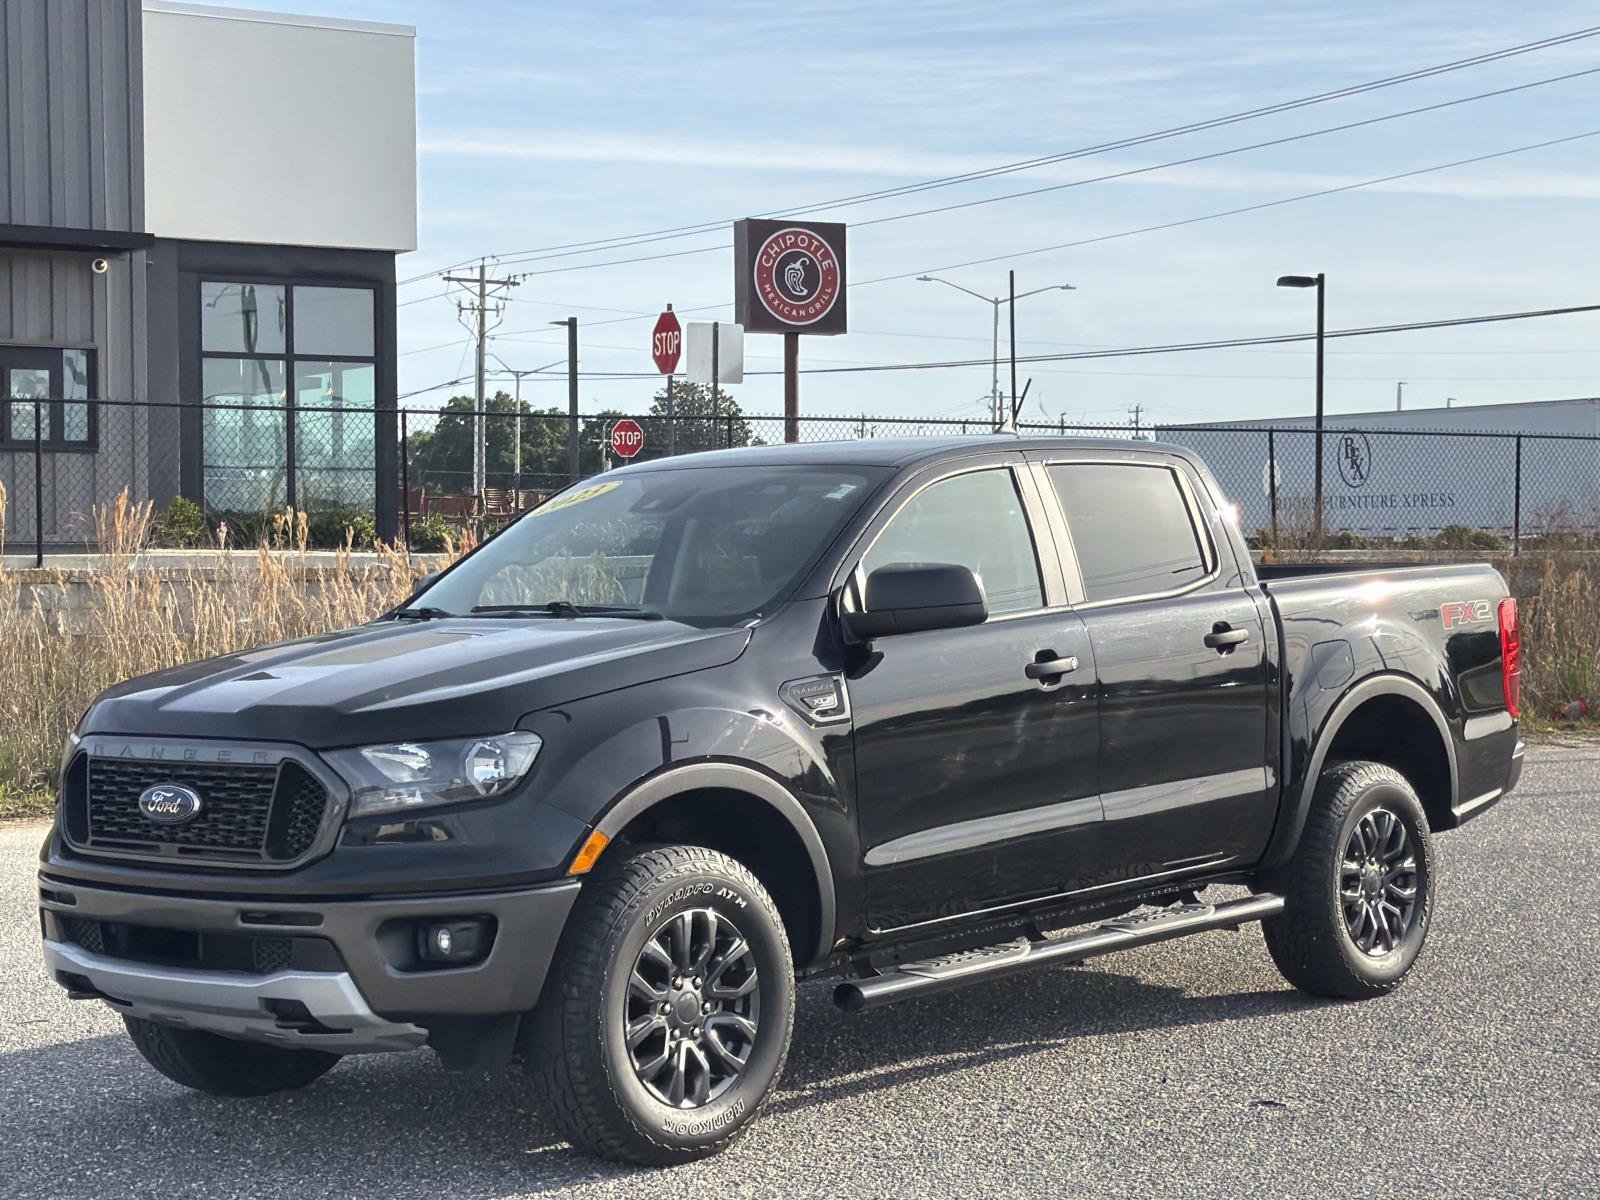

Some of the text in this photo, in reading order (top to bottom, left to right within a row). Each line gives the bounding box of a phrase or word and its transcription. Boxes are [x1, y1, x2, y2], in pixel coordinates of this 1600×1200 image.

[762, 235, 834, 270] CHIPOTLE
[763, 284, 832, 317] MEXICAN GRILL
[654, 331, 680, 355] STOP
[614, 431, 641, 445] STOP
[1323, 494, 1397, 509] FURNITURE
[1401, 493, 1455, 508] XPRESS
[1440, 599, 1494, 630] FX2
[92, 743, 268, 763] RANGER
[147, 790, 181, 814] Ford
